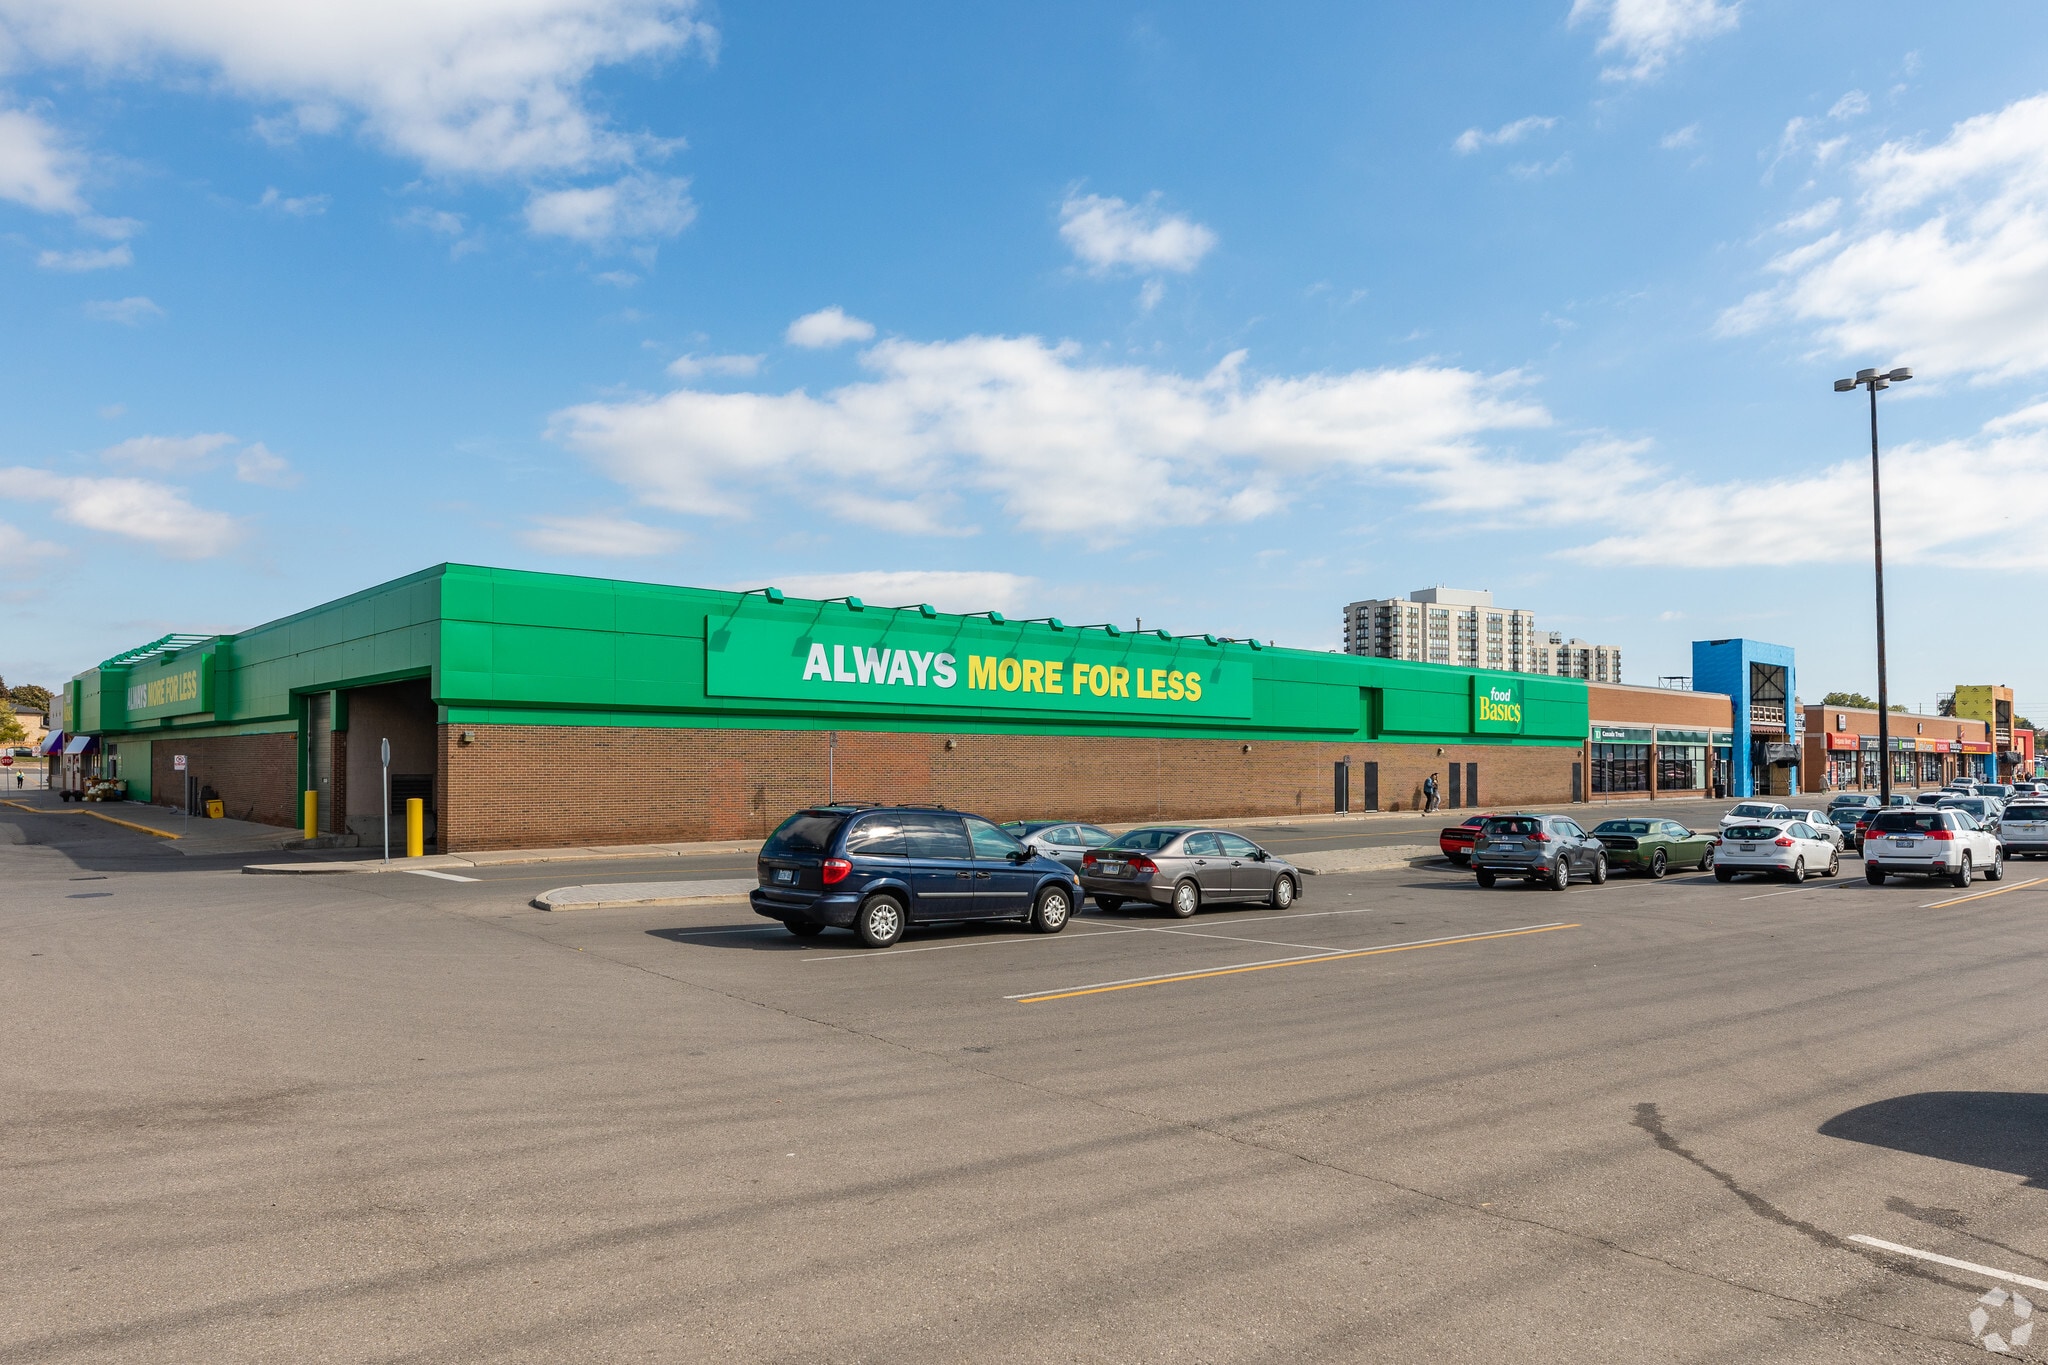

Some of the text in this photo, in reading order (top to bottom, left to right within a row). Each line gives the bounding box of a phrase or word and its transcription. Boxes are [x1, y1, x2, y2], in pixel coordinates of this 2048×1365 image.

[127, 670, 197, 711] ALWAYS MORE FOR LESS
[802, 642, 1202, 702] ALWAYS MORE FOR LESS
[1490, 686, 1511, 702] food
